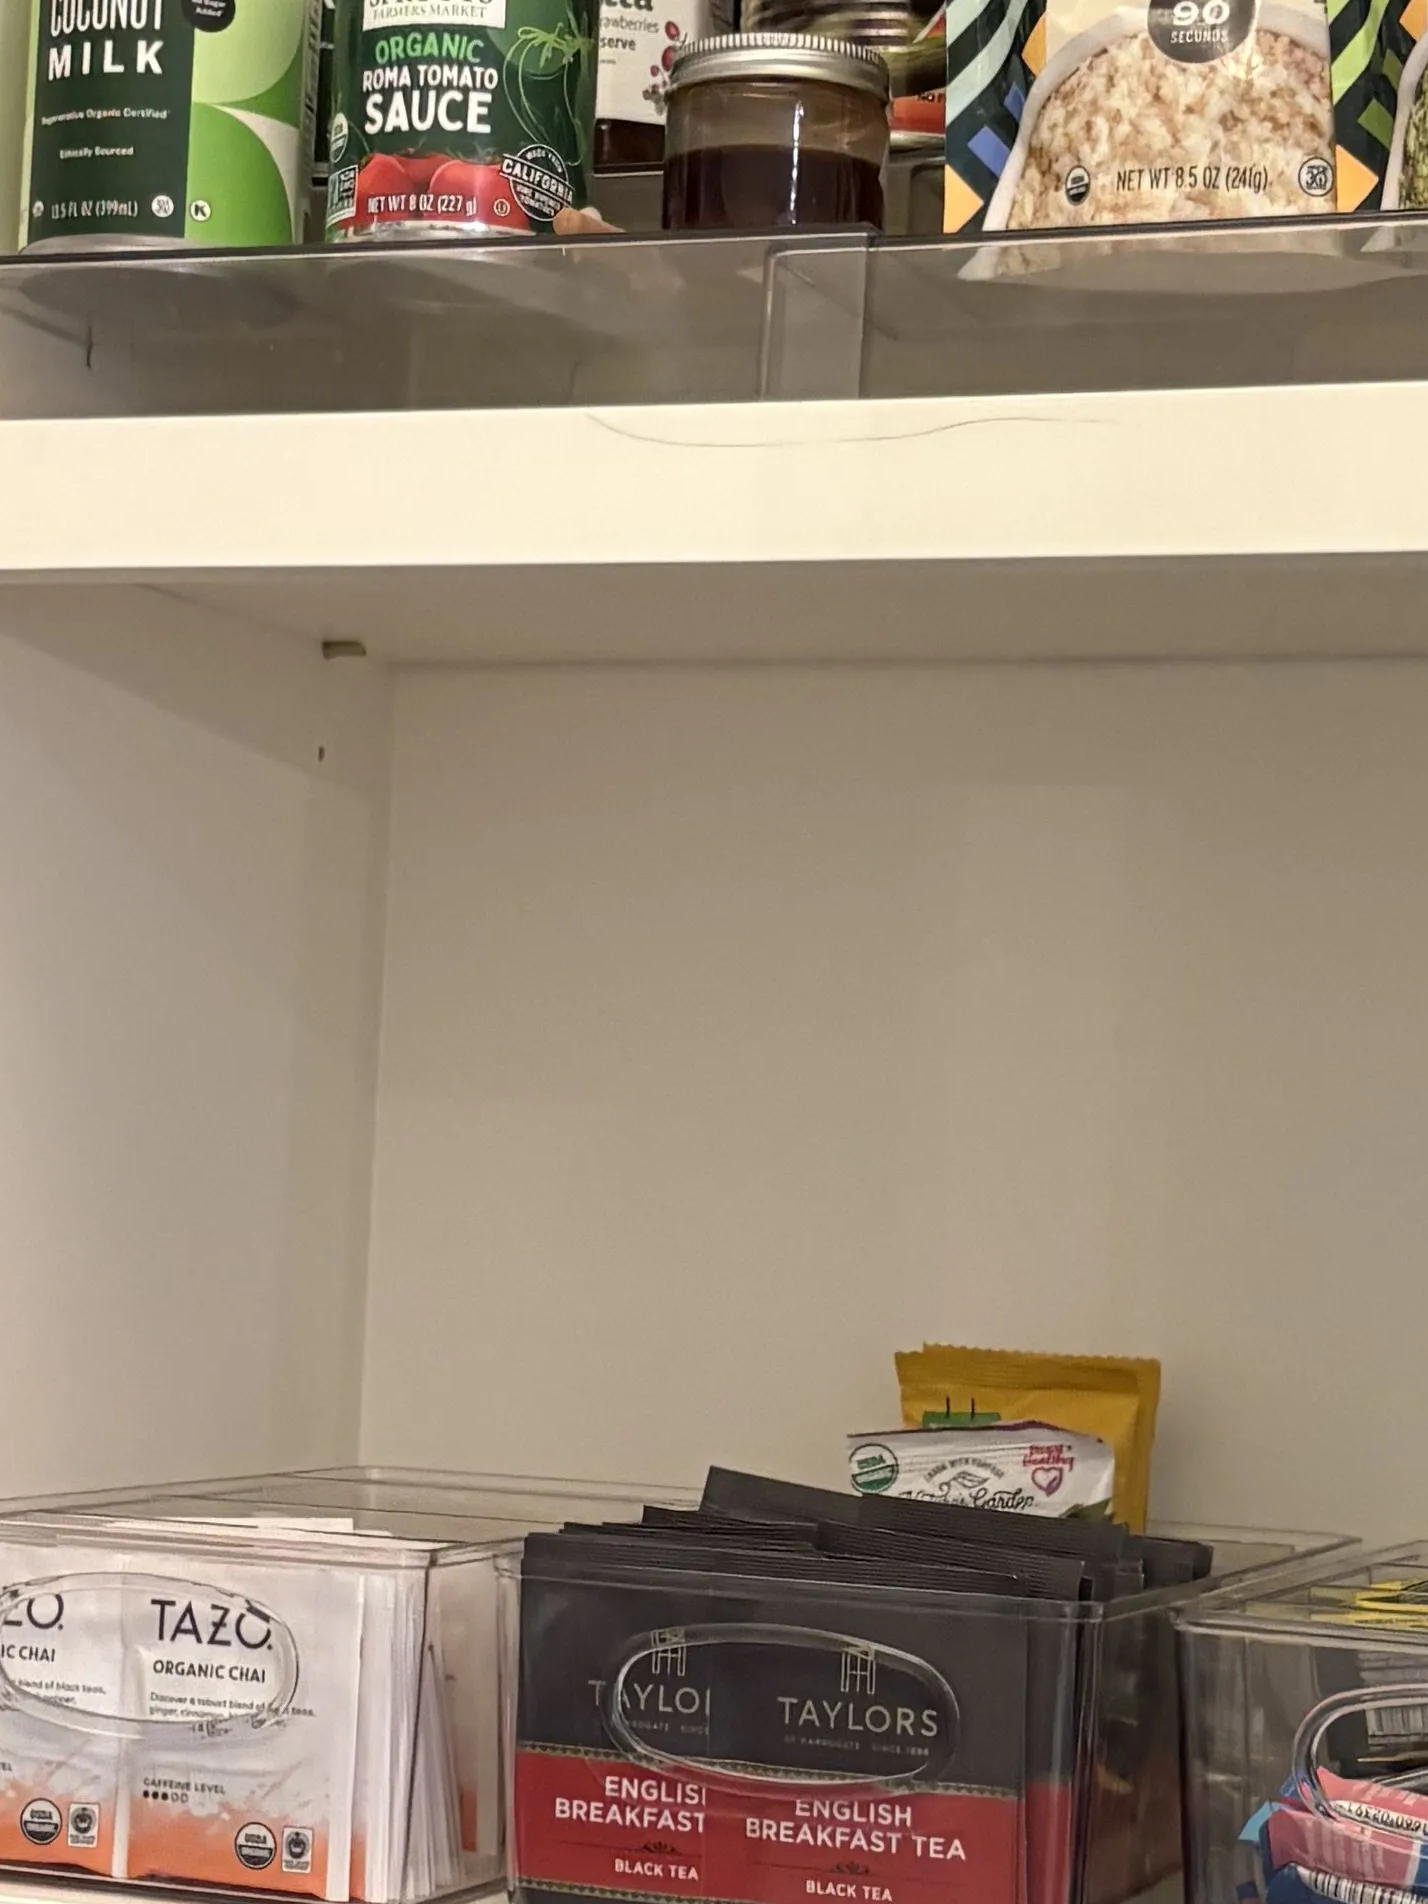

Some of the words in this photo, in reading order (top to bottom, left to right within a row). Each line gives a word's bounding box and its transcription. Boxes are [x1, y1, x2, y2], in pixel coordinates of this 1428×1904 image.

[372, 5, 426, 21] FARMERS
[428, 4, 487, 19] MARKET
[1172, 0, 1231, 26] 90
[48, 40, 164, 81] MILK
[375, 31, 484, 65] ORGANIC
[362, 65, 411, 92] ROMA
[417, 64, 499, 90] TOMATO
[363, 89, 493, 135] SAUCE
[502, 157, 573, 205] CALIFORNIA
[1116, 171, 1144, 193] NET
[1149, 168, 1172, 192] WT
[1202, 165, 1221, 190] OZ
[367, 196, 384, 213] NET
[387, 196, 406, 212] WT
[419, 195, 433, 211] OZ
[19, 1646, 57, 1663] CHAI
[152, 1658, 226, 1680] ORGANIC
[228, 1665, 267, 1684] CHAI
[776, 1697, 938, 1737] TAYLORS
[143, 1777, 192, 1793] CAFFEINE
[194, 1782, 227, 1796] LEVEL
[604, 1775, 706, 1806] ENGLIS
[553, 1795, 708, 1835] BREAKFAST
[795, 1798, 912, 1827] ENGLISH
[745, 1817, 902, 1855] BREAKFAST
[911, 1835, 966, 1861] TEA
[614, 1858, 664, 1878] BLACK
[668, 1864, 699, 1881] TEA
[805, 1879, 857, 1898] BLACK
[863, 1885, 893, 1902] TEA
